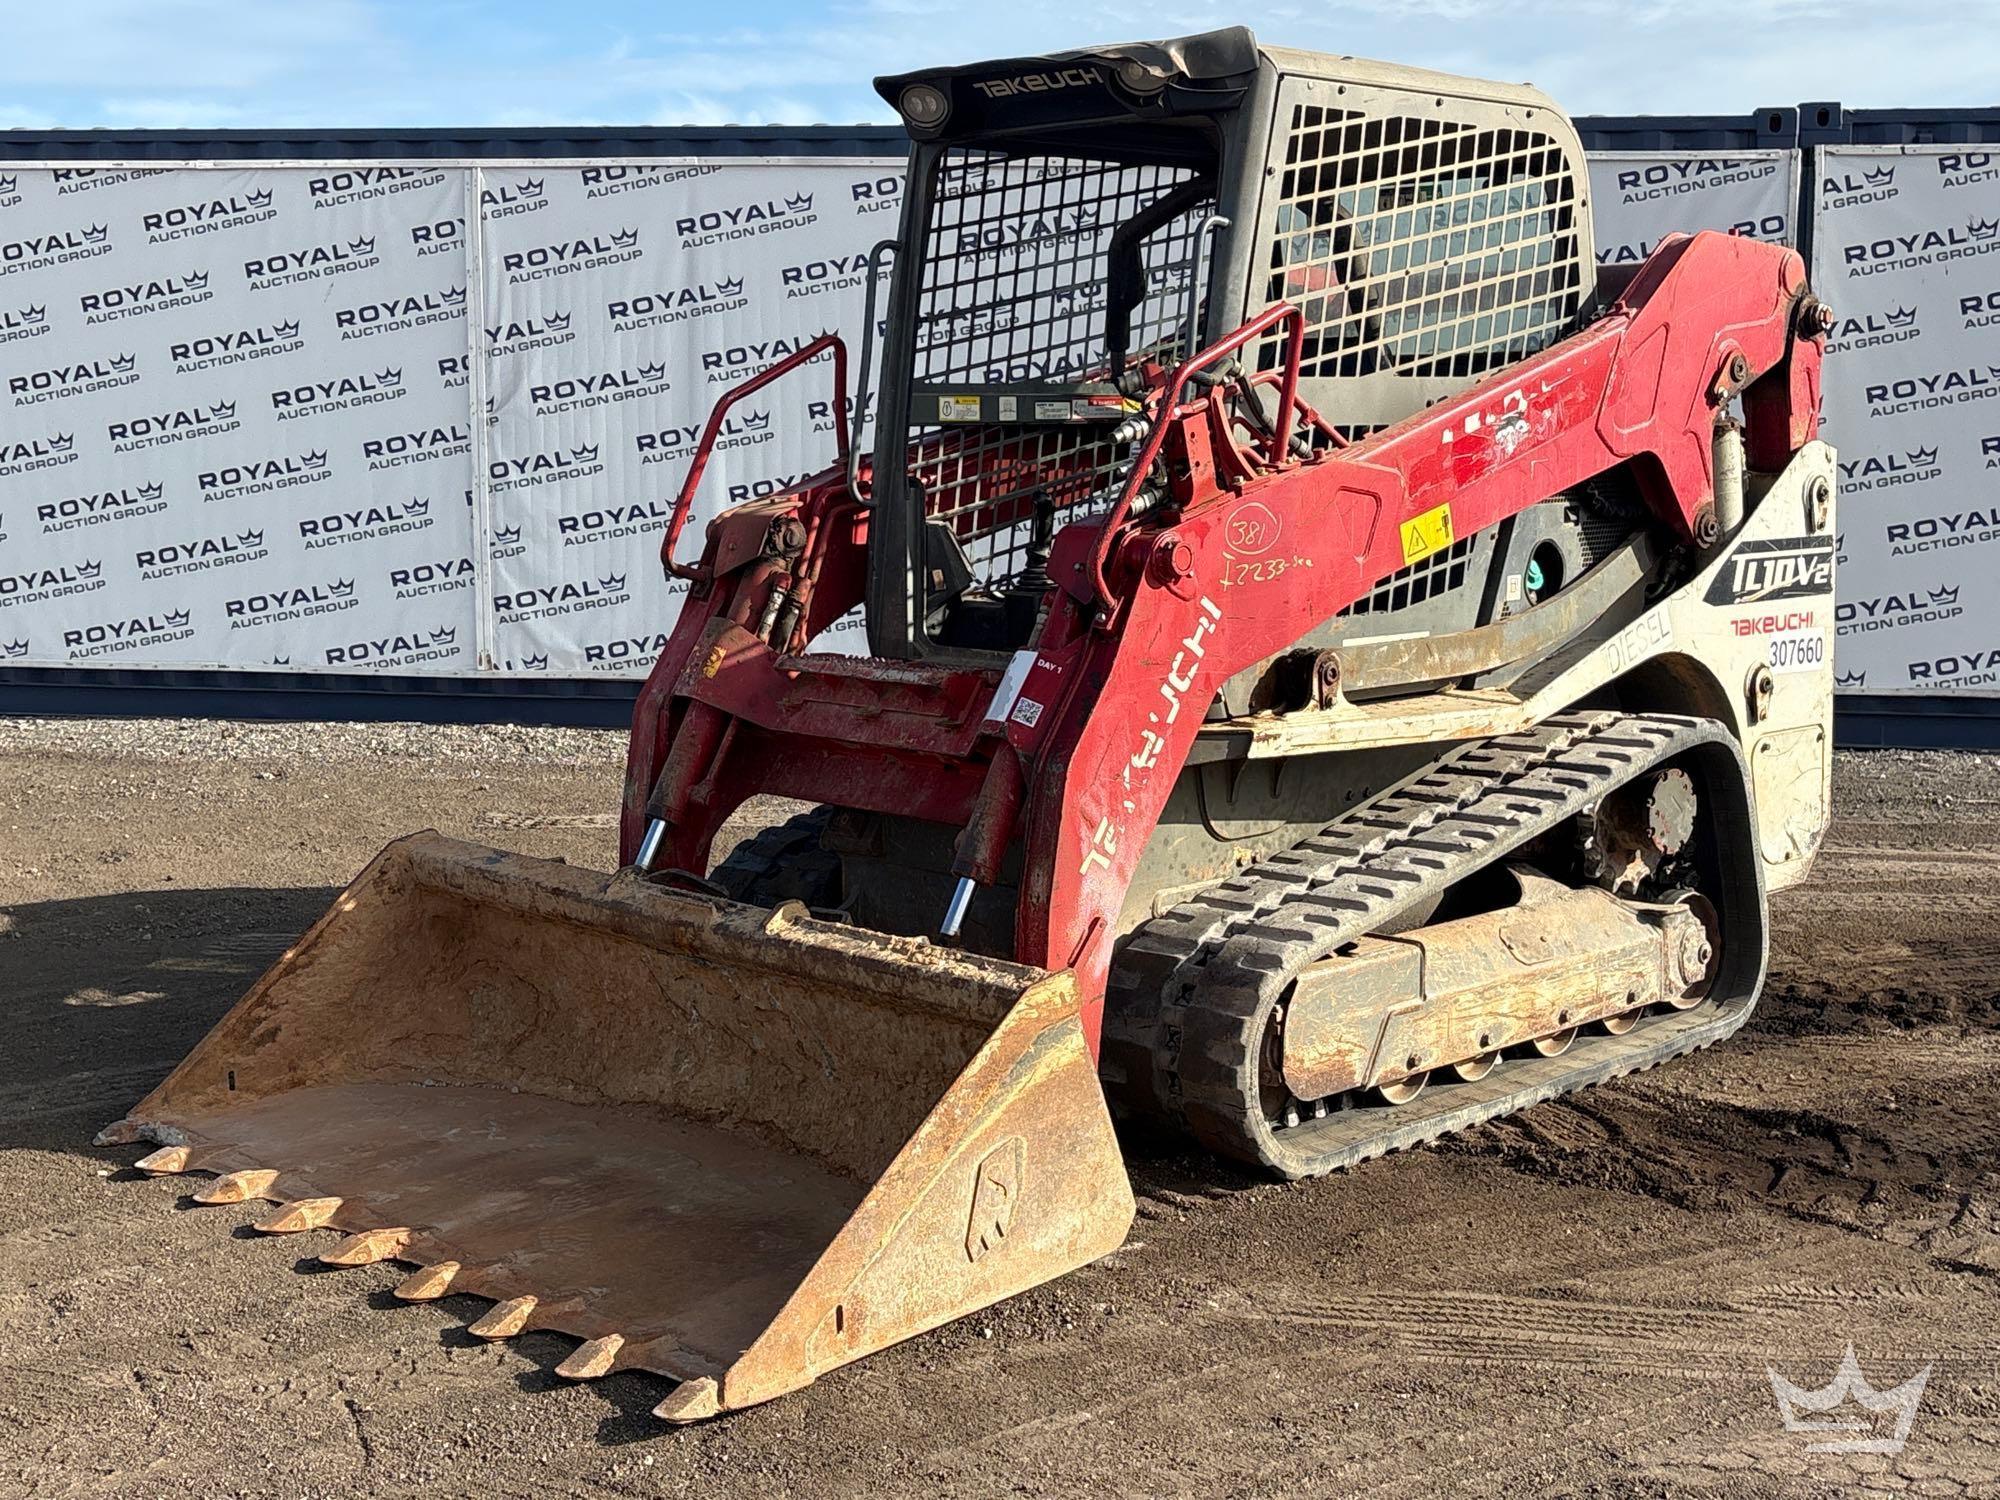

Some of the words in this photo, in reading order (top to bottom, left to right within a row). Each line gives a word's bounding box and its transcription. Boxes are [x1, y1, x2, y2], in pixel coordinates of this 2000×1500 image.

[972, 67, 1104, 98] TAKEUCH
[58, 173, 127, 195] AUCTION
[315, 187, 385, 209] AUCTION
[389, 174, 445, 194] GROUP
[587, 176, 660, 199] AUCTION
[1623, 180, 1705, 204] AUCTION
[1710, 166, 1776, 186] GROUP
[1943, 169, 1998, 188] AUCTI
[143, 198, 247, 231] ROYAL
[491, 200, 548, 219] GROUP
[857, 198, 902, 214] AUCT
[1834, 189, 1899, 209] GROUP
[149, 222, 218, 244] AUCTION
[222, 210, 277, 228] GROUP
[676, 202, 785, 236] ROYAL
[682, 227, 755, 249] AUCTION
[758, 215, 817, 234] GROUP
[0, 232, 82, 262] OYAL
[58, 245, 112, 263] GROUP
[245, 244, 349, 278] ROYAL
[417, 239, 465, 257] AUCTI
[504, 237, 611, 272] ROYAL
[1844, 228, 1967, 264] ROYAL
[250, 269, 320, 291] AUCTION
[324, 257, 379, 276] GROUP
[510, 262, 581, 284] AUCTION
[585, 250, 642, 269] GROUP
[1849, 254, 1932, 278] AUCTION
[81, 279, 183, 312] ROYAL
[608, 285, 716, 320] ROYAL
[787, 276, 861, 298] AUCTION
[87, 303, 155, 325] AUCTION
[158, 292, 213, 310] GROUP
[336, 294, 441, 328] ROYAL
[614, 310, 687, 332] AUCTION
[690, 298, 748, 317] GROUP
[342, 319, 412, 340] AUCTION
[484, 320, 544, 343] YAL
[518, 333, 575, 351] GROUP
[1827, 315, 1886, 340] YAL
[1856, 329, 1920, 347] GROUP
[170, 328, 274, 361] ROYAL
[176, 352, 245, 374] AUCTION
[249, 341, 304, 359] GROUP
[9, 362, 110, 394] ROYAL
[15, 386, 82, 406] AUCTION
[86, 374, 140, 392] GROUP
[272, 376, 376, 408] ROYAL
[530, 370, 639, 404] ROYAL
[1866, 369, 1988, 404] ROYAL
[278, 400, 347, 421] AUCTION
[351, 388, 406, 406] GROUP
[536, 395, 609, 416] AUCTION
[612, 383, 670, 402] GROUP
[1871, 395, 1953, 418] AUCTION
[1958, 386, 2000, 402] GRO
[109, 408, 210, 441] ROYAL
[114, 432, 182, 453] AUCTION
[186, 421, 240, 438] GROUP
[363, 426, 468, 458] ROYAL
[716, 432, 774, 450] GROUP
[25, 453, 78, 471] GROUP
[369, 450, 439, 471] AUCTION
[442, 443, 472, 456] GRO
[490, 451, 572, 479] OYAL
[1838, 455, 1907, 479] YAL
[198, 458, 302, 490] ROYAL
[204, 482, 273, 502] AUCTION
[276, 471, 332, 488] GROUP
[546, 465, 603, 482] GROUP
[1877, 468, 1942, 487] GROUP
[38, 490, 138, 521] ROYAL
[43, 513, 110, 534] AUCTION
[114, 502, 167, 520] GROUP
[558, 502, 666, 534] ROYAL
[300, 506, 403, 537] ROYAL
[305, 530, 375, 550] AUCTION
[378, 518, 433, 536] GROUP
[564, 526, 637, 546] AUCTION
[136, 536, 238, 568] ROYAL
[491, 546, 526, 560] OUP
[1892, 534, 1974, 556] AUCTION
[0, 567, 77, 594] OYAL
[142, 560, 210, 580] AUCTION
[213, 550, 268, 567] GROUP
[390, 558, 474, 587] ROYA
[0, 590, 49, 607] CTION
[52, 580, 106, 597] GROUP
[226, 586, 328, 617] ROYAL
[396, 579, 466, 600] AUCTION
[493, 581, 600, 612] ROYAL
[231, 610, 300, 630] AUCTION
[304, 599, 358, 616] GROUP
[499, 605, 570, 624] AUCTION
[574, 594, 630, 611] GROUP
[1835, 593, 1928, 622] OYAL
[1836, 619, 1893, 636] CTION
[1898, 607, 1963, 625] GROUP
[64, 616, 165, 647] ROYAL
[1730, 611, 1814, 636] TAKEUCHI
[70, 640, 137, 660] AUCTION
[140, 629, 194, 646] GROUP
[326, 634, 430, 664] ROYAL
[404, 647, 460, 664] GROUP
[585, 634, 668, 661] ROYA
[1769, 637, 1823, 667] 307660
[1037, 659, 1056, 672] DAY
[1057, 666, 1063, 674] 1
